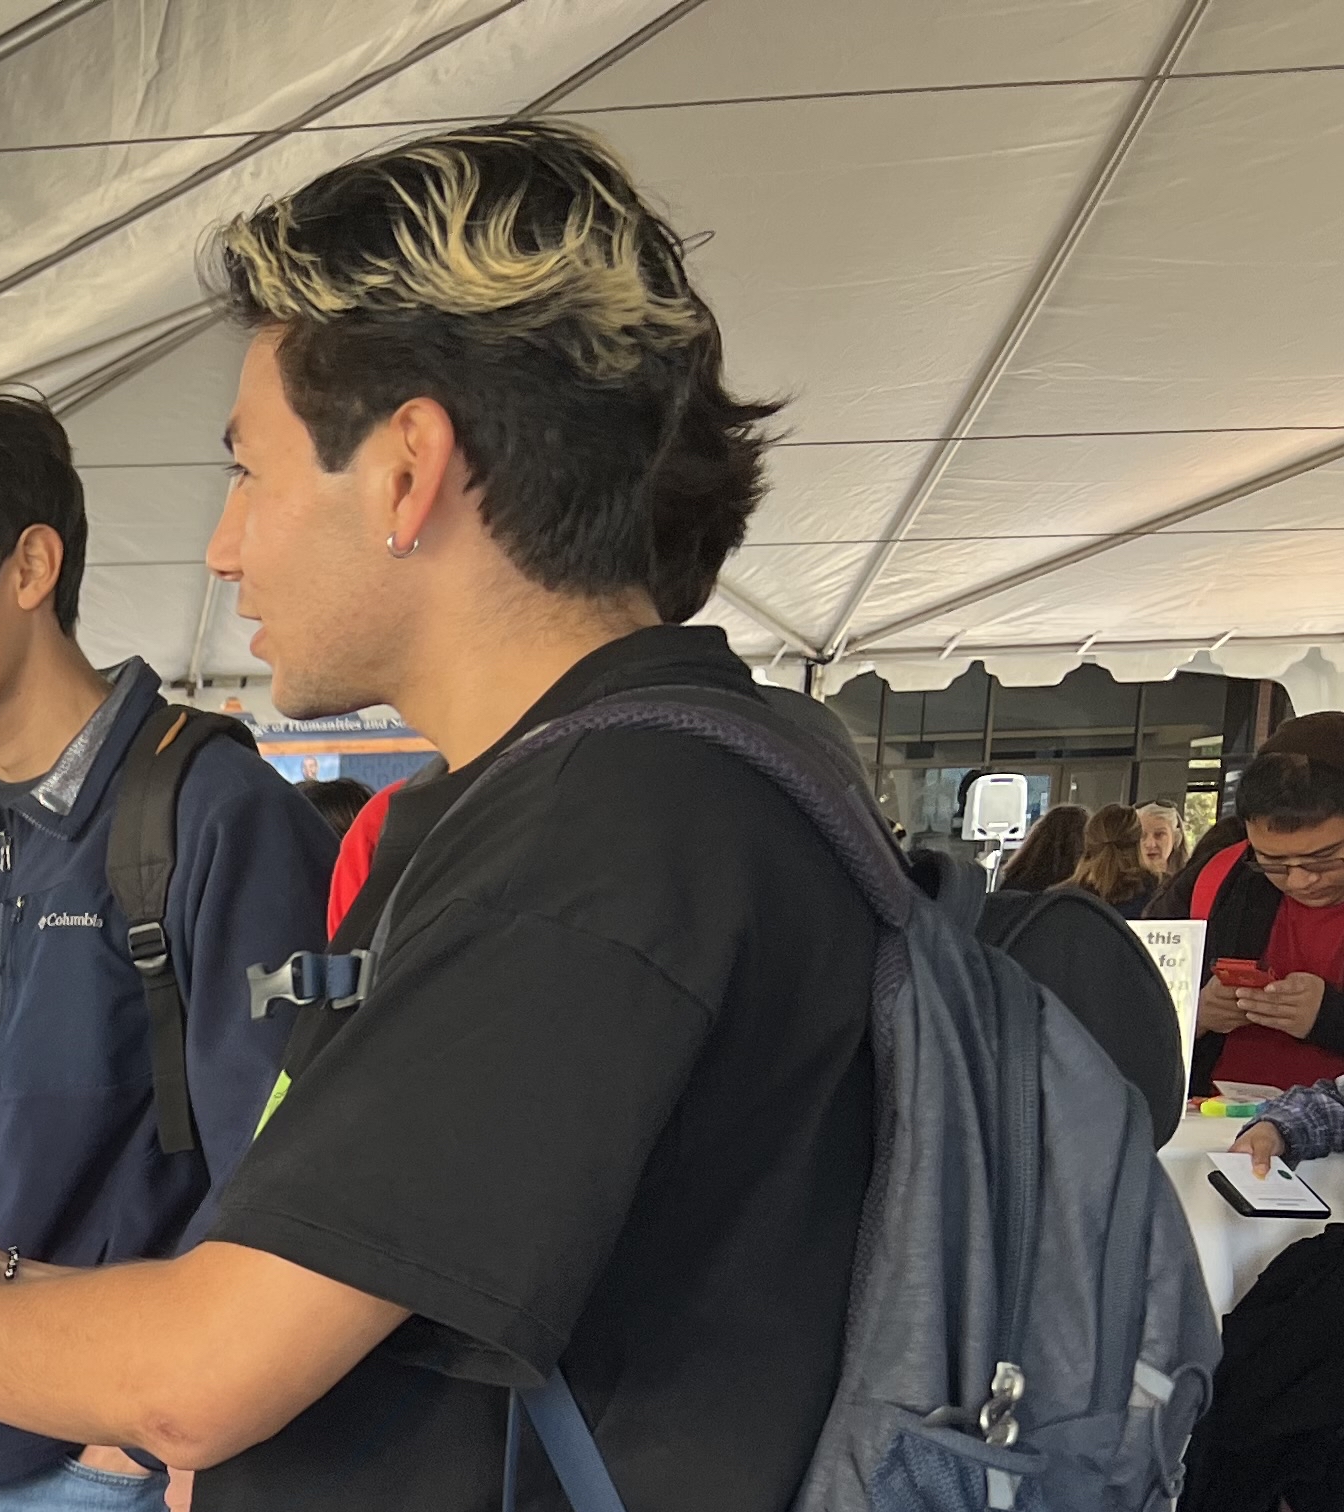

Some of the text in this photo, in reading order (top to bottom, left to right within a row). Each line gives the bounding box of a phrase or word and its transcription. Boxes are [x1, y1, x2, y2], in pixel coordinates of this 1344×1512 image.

[288, 717, 362, 733] Humanities
[364, 718, 388, 730] and
[46, 912, 104, 928] Columbia
[1147, 931, 1182, 945] this
[1159, 954, 1186, 968] for
